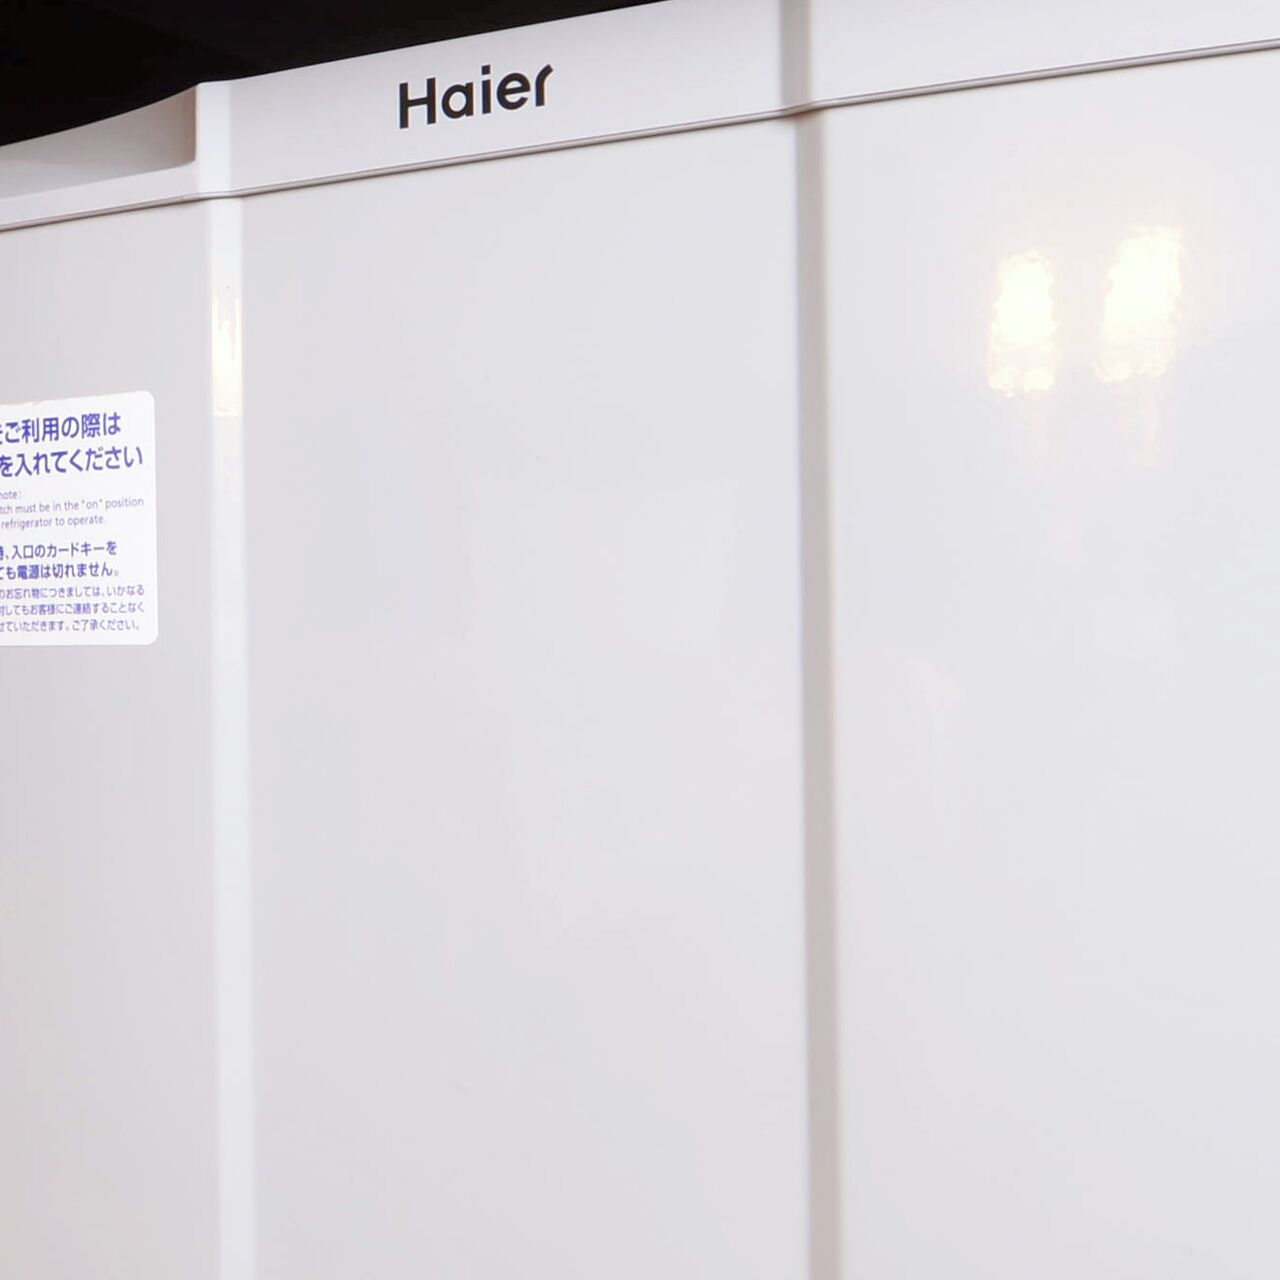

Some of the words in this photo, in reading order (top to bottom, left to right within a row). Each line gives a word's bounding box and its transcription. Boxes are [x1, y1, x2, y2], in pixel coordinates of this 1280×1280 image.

[399, 63, 554, 129] Haier
[15, 504, 37, 514] must
[39, 502, 50, 513] be
[52, 502, 61, 512] in
[64, 501, 80, 511] the
[105, 498, 144, 511] position
[1, 517, 52, 531] refrigerator
[55, 517, 65, 527] to
